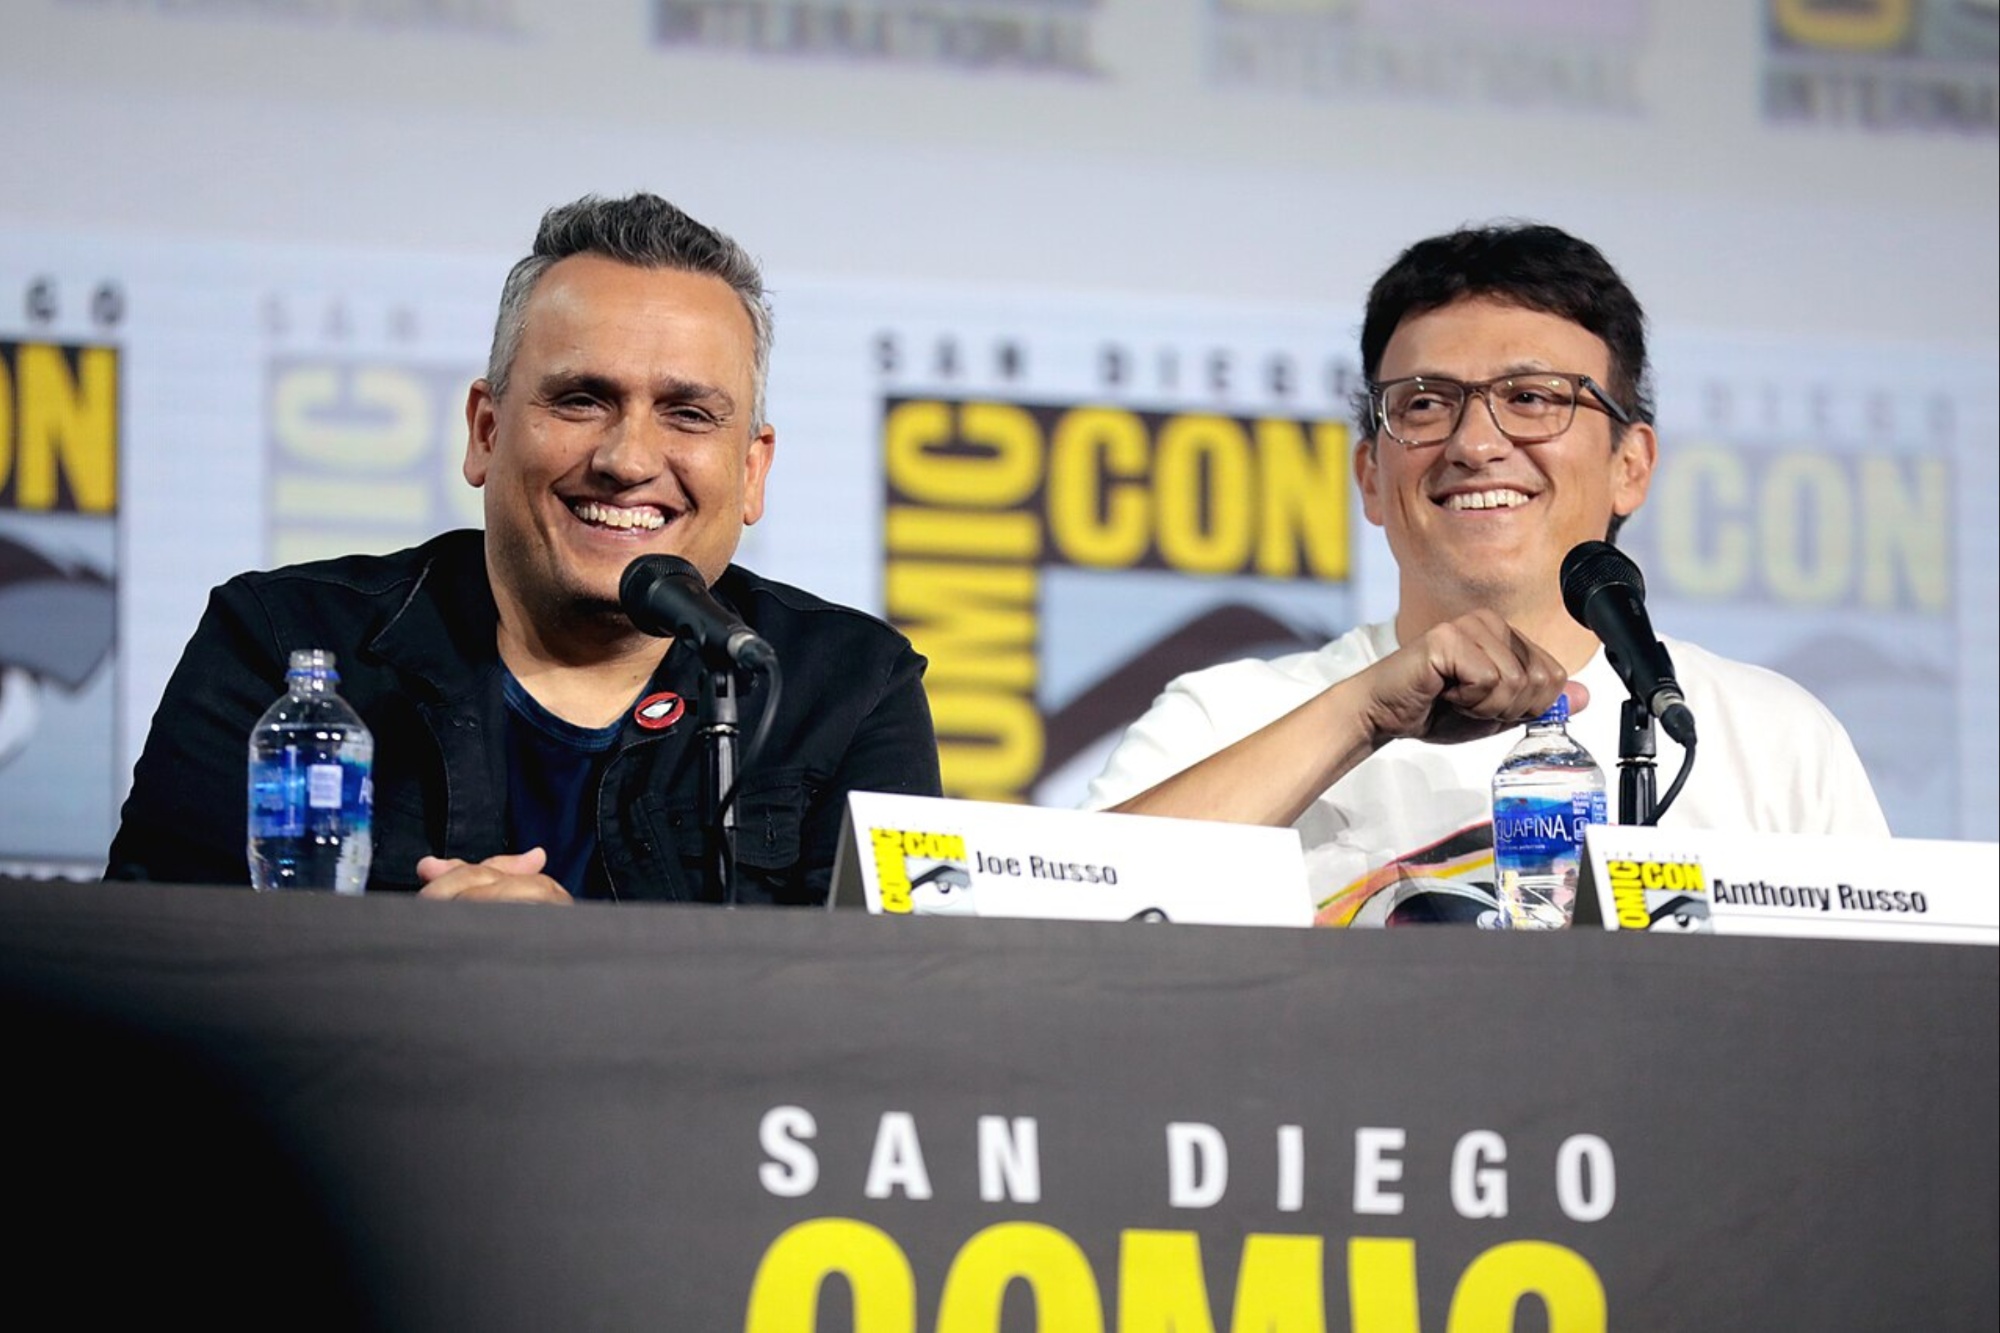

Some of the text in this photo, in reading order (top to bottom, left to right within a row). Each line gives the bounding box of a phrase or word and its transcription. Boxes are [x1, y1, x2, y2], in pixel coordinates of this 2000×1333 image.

[26, 277, 126, 326] GO
[871, 333, 1028, 390] SAN
[0, 342, 119, 515] N
[272, 368, 434, 572] IC
[1046, 404, 1351, 584] CON
[1657, 440, 1948, 618] CON
[884, 400, 1044, 797] OMIC
[1495, 814, 1568, 843] QUAFINA
[976, 850, 1117, 886] Joe Russo
[1606, 860, 1651, 929] OMIC
[1641, 861, 1706, 893] CON
[1712, 878, 1928, 914] Anthony Russo
[758, 1104, 1618, 1223] SAN DIEGO
